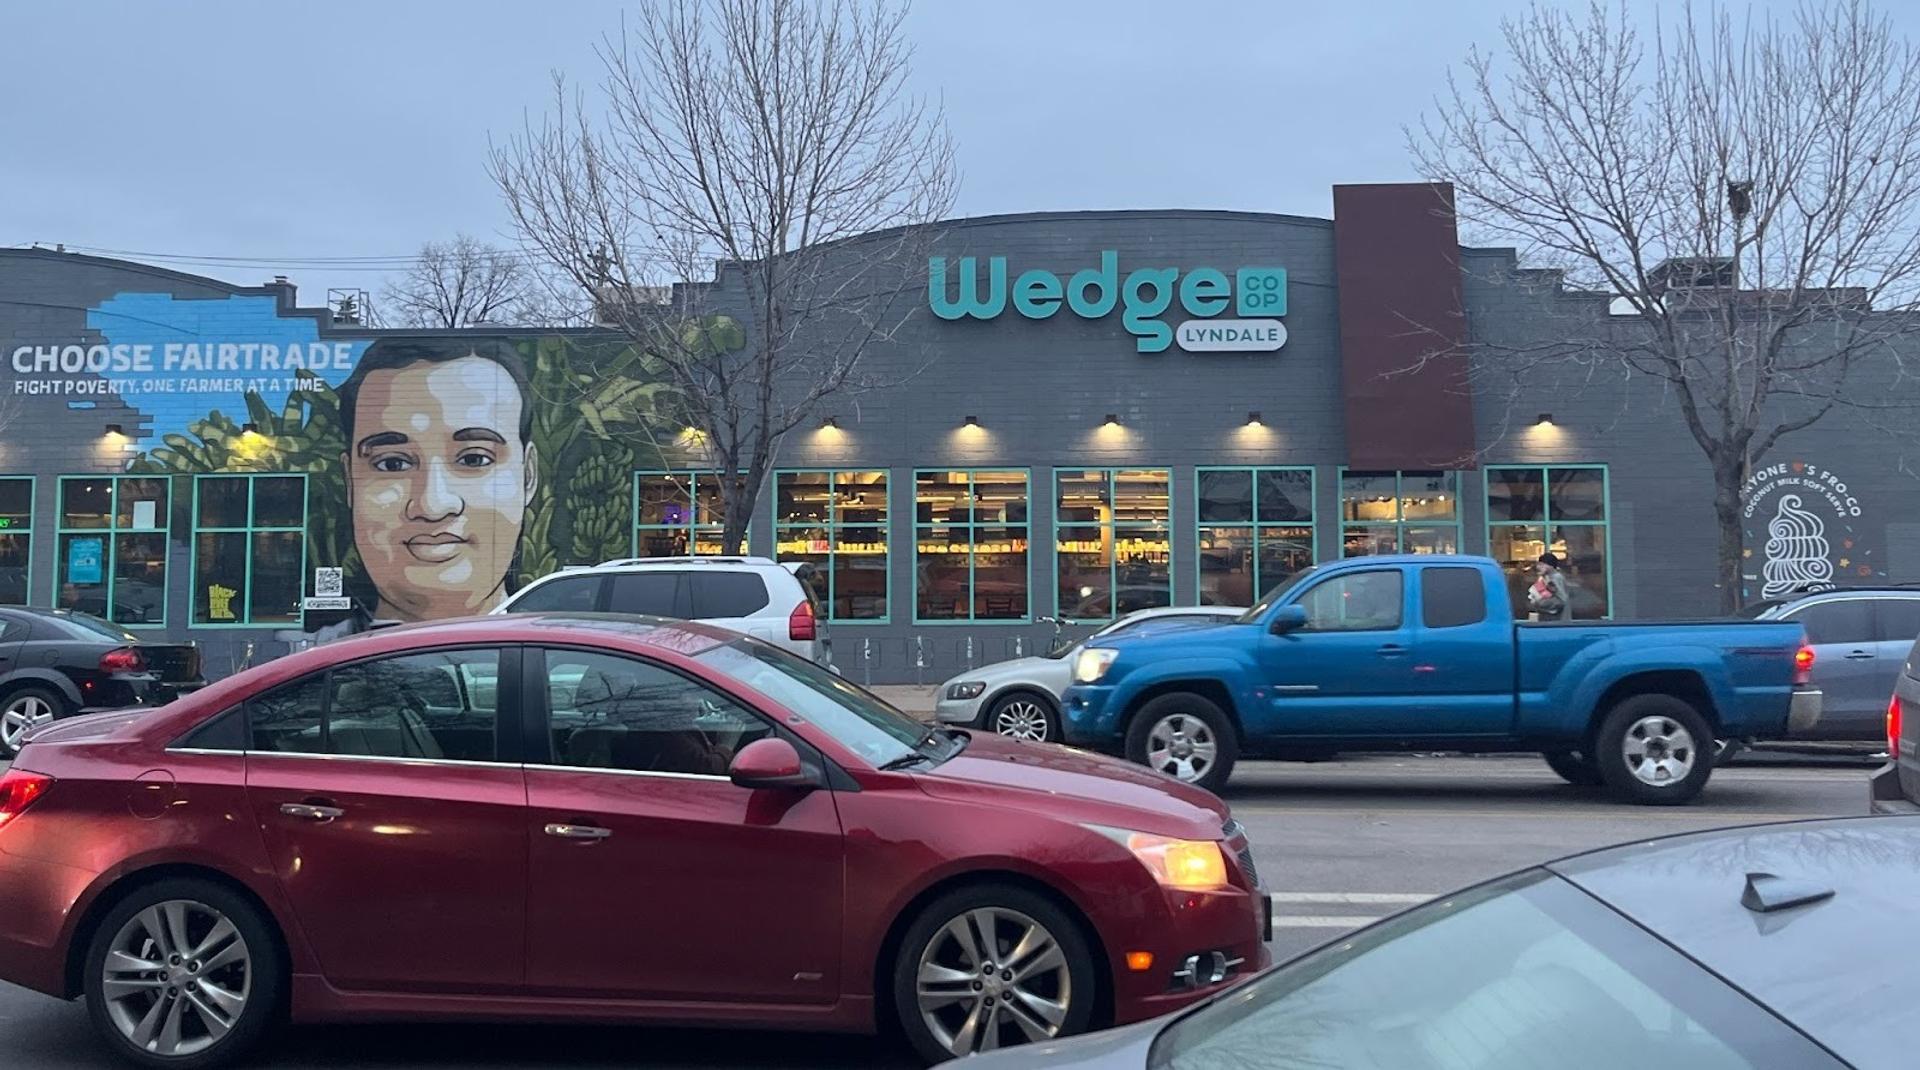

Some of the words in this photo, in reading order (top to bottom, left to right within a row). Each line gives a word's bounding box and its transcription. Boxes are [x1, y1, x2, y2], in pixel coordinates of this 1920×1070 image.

[1245, 275, 1280, 291] CO
[928, 250, 1231, 353] Wedge
[1245, 293, 1280, 308] OP
[1186, 328, 1279, 342] LYNDALE
[12, 344, 154, 373] CHOOSE
[163, 343, 353, 370] FAIRTRADE
[14, 380, 62, 394] FIGHT
[64, 379, 140, 395] POVERTY,
[142, 379, 176, 393] ONE
[180, 378, 243, 393] FARMER
[247, 378, 267, 393] AT
[269, 379, 281, 391] A
[284, 378, 325, 392] TIME
[1744, 482, 1776, 518] COCONUT
[1777, 477, 1800, 486] MILK
[1803, 478, 1826, 493] SOFT
[1825, 492, 1846, 518] SERVE
[1820, 470, 1862, 516] FRO-CO
